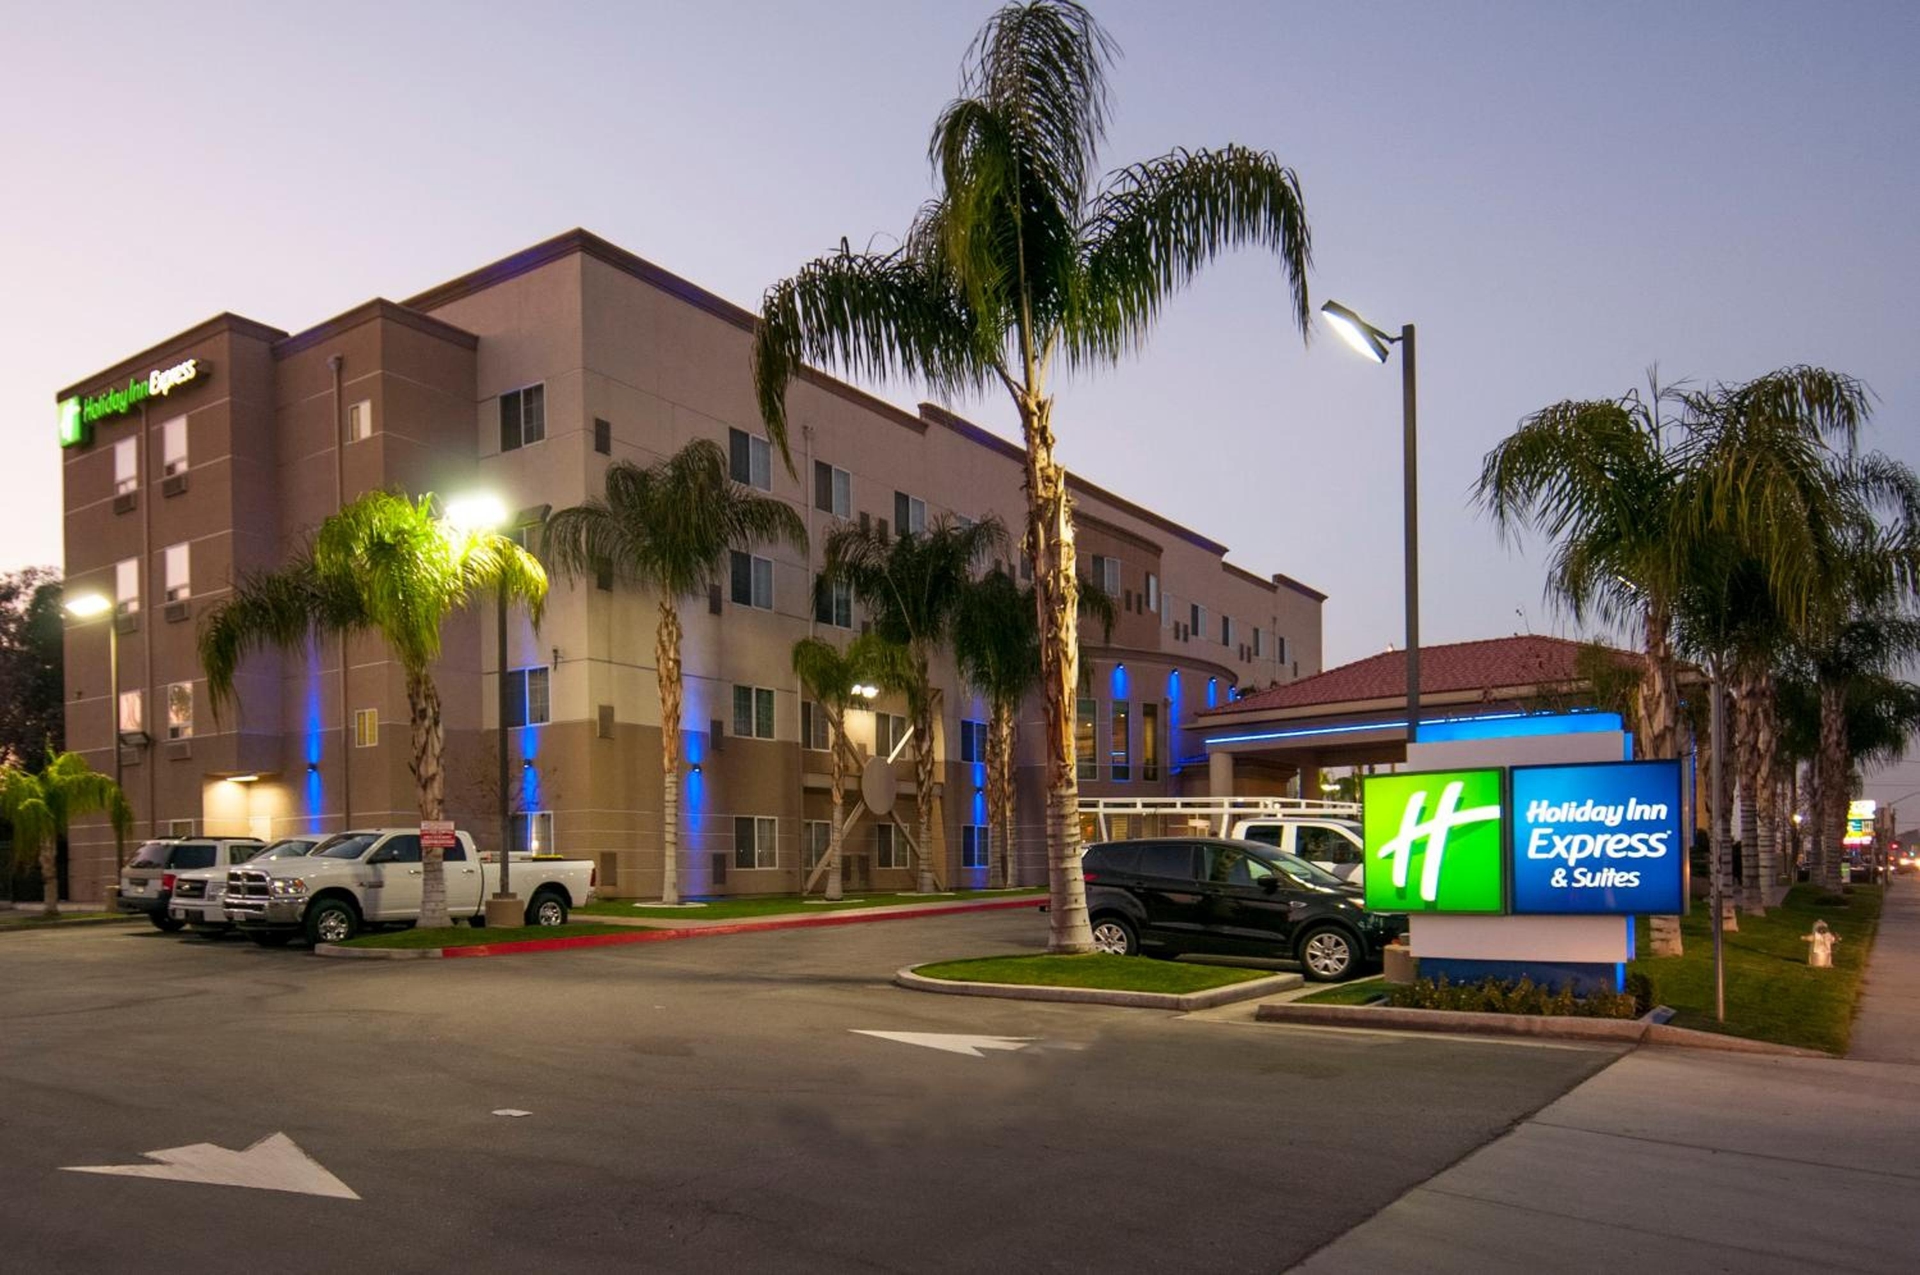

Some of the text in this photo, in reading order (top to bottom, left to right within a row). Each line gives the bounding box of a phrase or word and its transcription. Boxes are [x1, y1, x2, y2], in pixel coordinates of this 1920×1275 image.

[84, 388, 128, 422] Holiday
[128, 378, 150, 403] Inn
[1526, 797, 1668, 826] Holiday Inn
[1377, 781, 1501, 901] H
[1527, 828, 1668, 866] Express
[1551, 867, 1640, 888] & Suites
